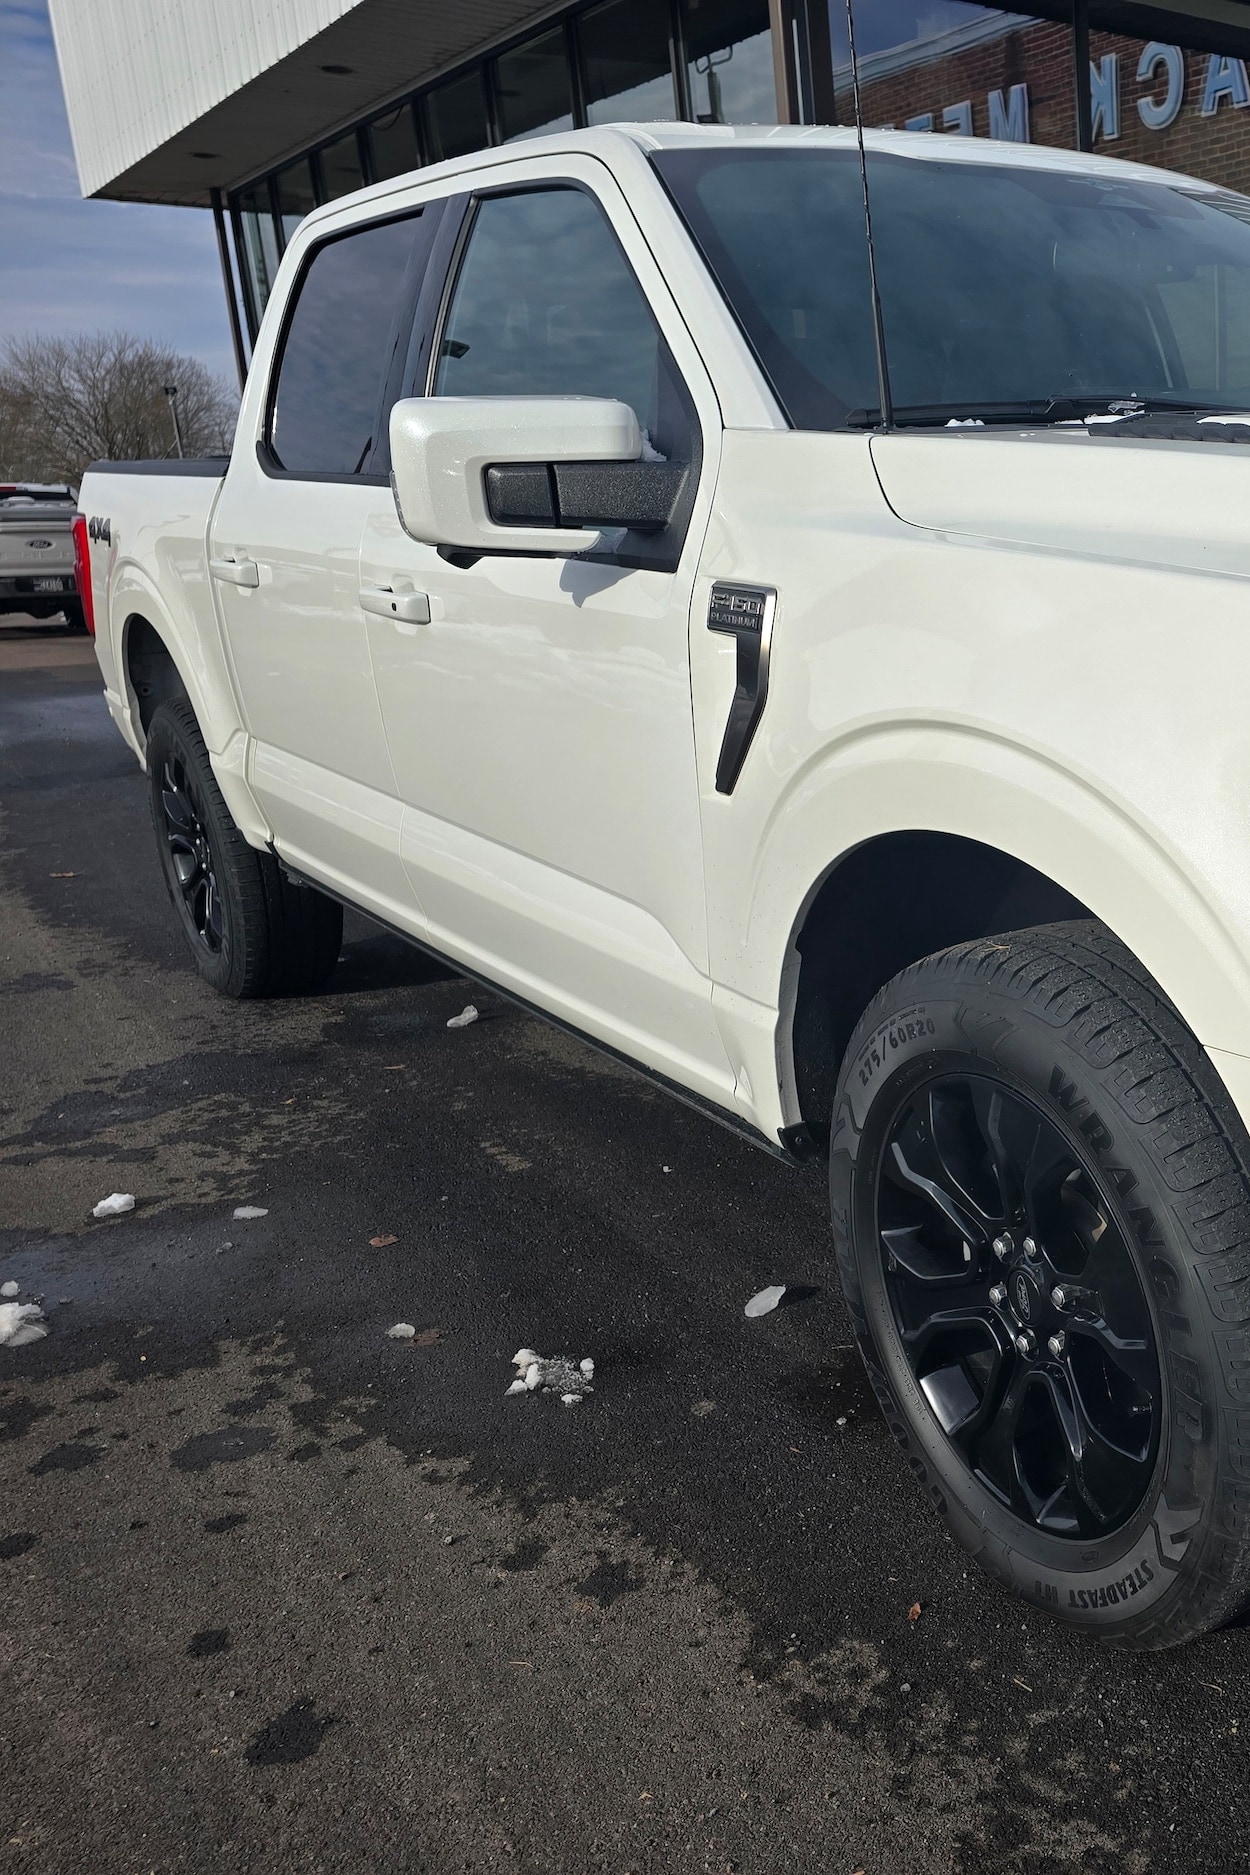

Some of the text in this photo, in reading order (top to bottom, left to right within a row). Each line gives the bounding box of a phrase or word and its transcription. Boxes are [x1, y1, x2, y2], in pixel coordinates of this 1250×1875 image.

[711, 592, 764, 615] F-150
[711, 611, 759, 629] PLATINUM
[858, 1017, 936, 1086] 275/60R20
[1048, 1062, 1204, 1442] WRANGLER
[1067, 1558, 1155, 1610] STEADFAST
